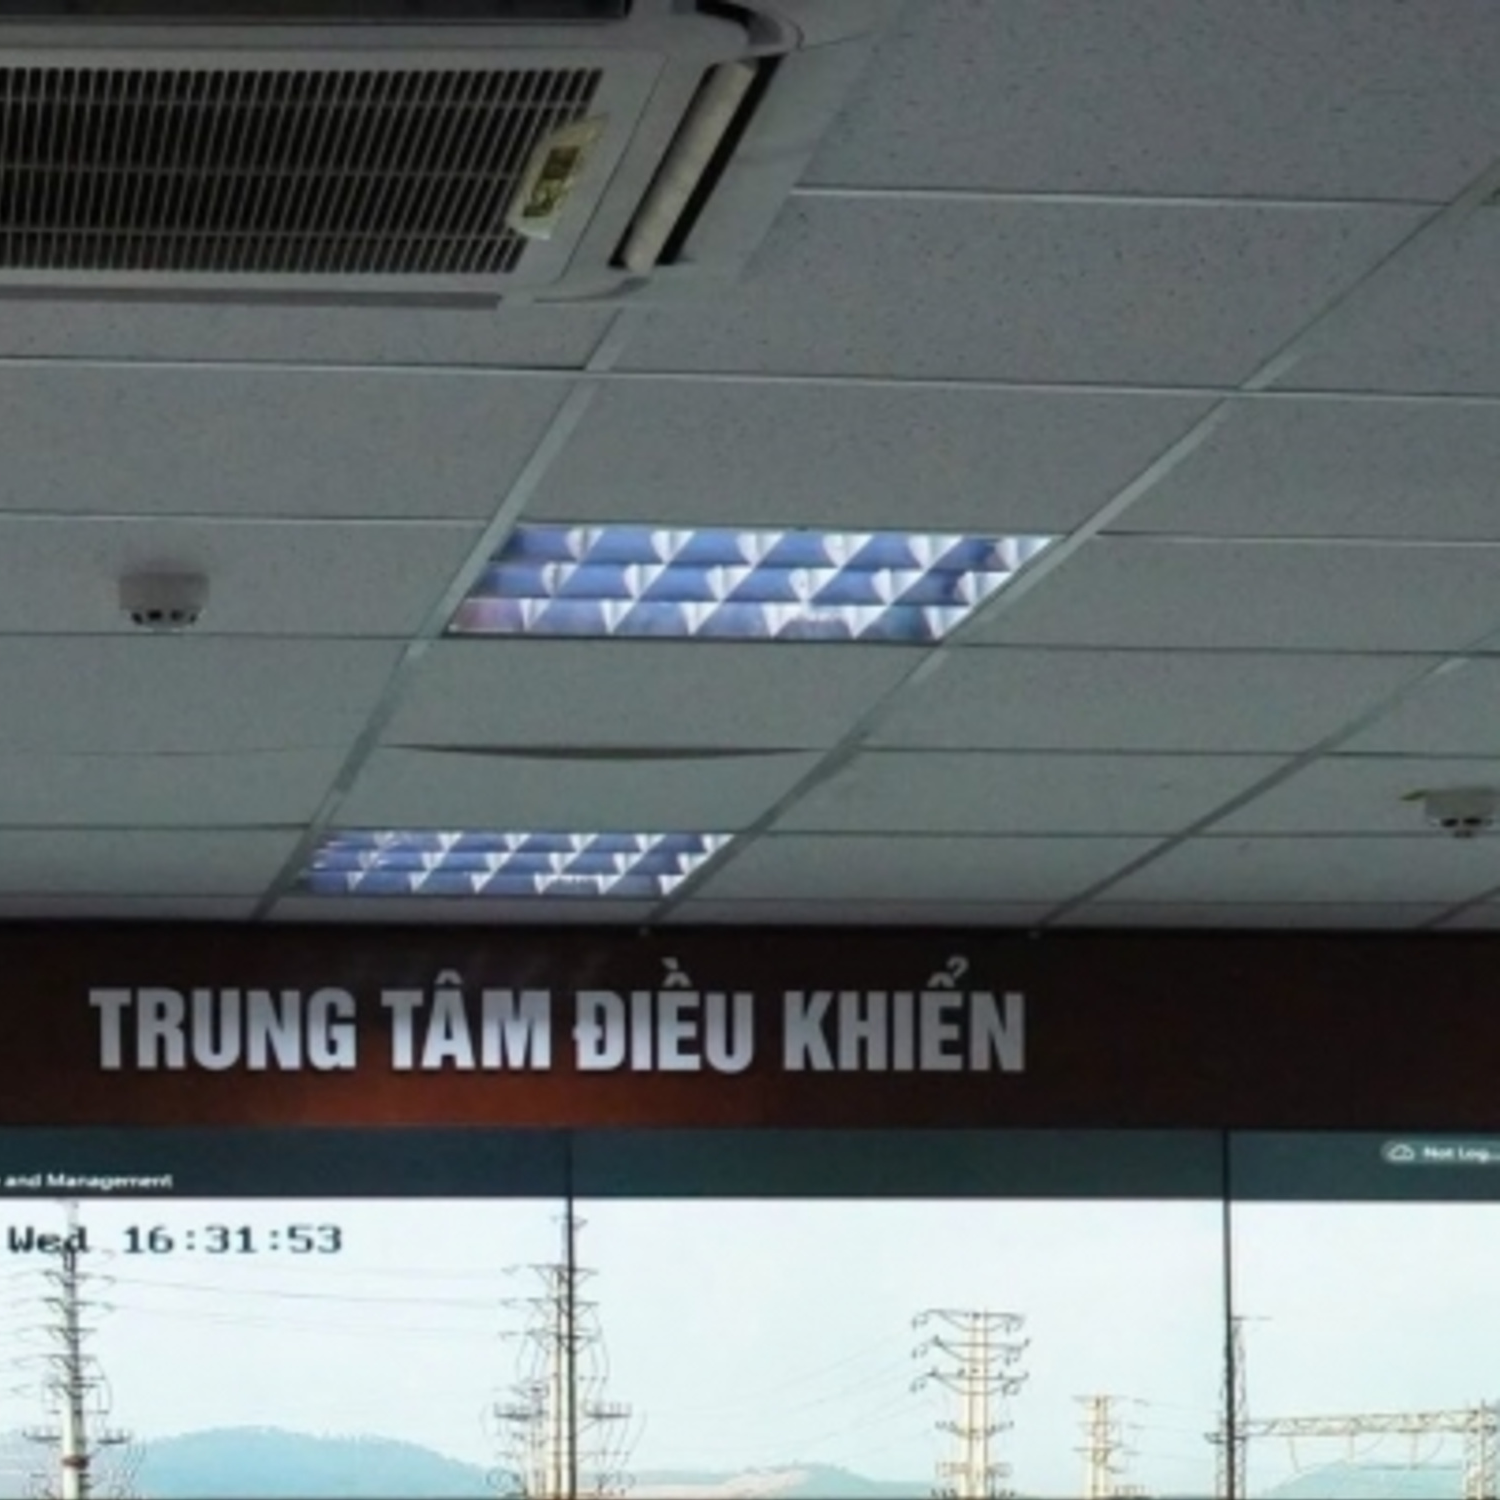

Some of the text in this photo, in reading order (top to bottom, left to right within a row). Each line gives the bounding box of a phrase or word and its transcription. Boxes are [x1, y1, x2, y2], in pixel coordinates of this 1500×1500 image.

[89, 957, 1025, 1074] TRUNG TÂM ĐIỀU KHIỂN
[4, 1173, 41, 1188] and
[46, 1173, 173, 1190] Management
[7, 1225, 90, 1254] Wed
[123, 1225, 344, 1255] 16:31:53
